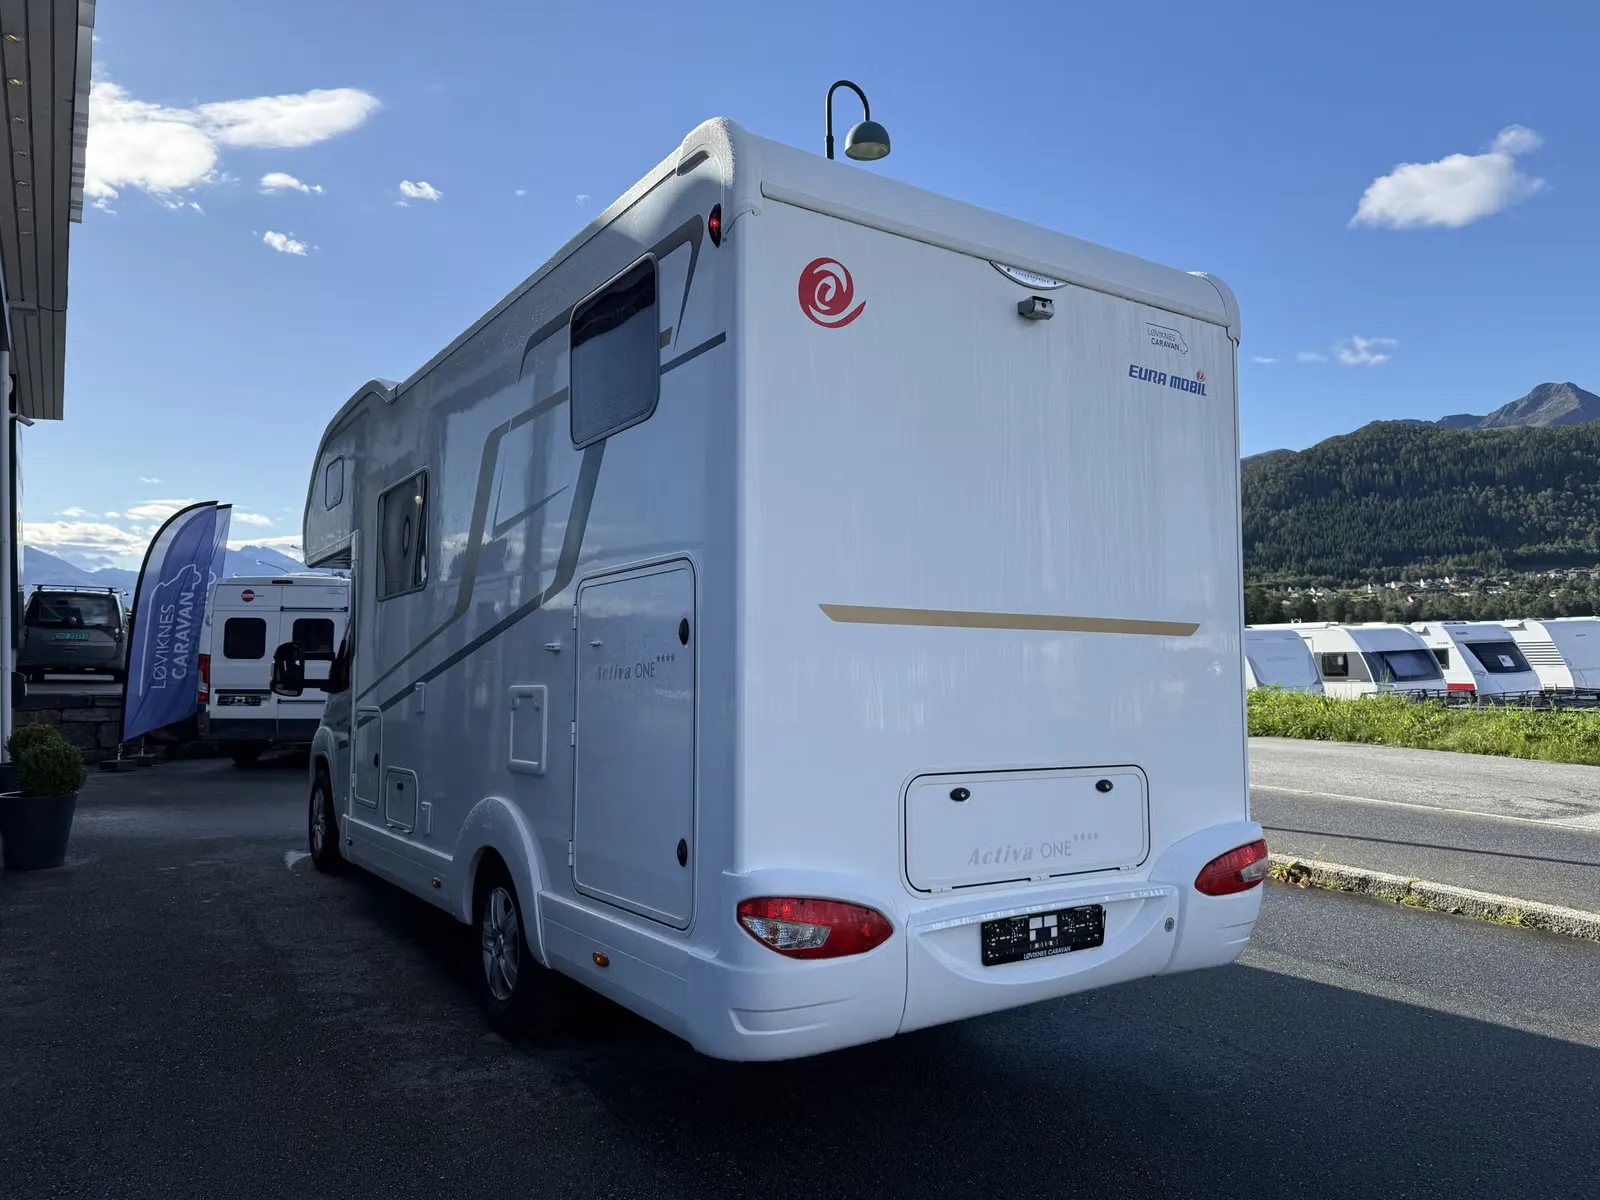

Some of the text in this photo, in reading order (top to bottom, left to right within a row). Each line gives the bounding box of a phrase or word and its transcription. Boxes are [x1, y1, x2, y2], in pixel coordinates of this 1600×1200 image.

[1151, 338, 1180, 351] CARAVAN
[1128, 364, 1207, 396] EURA MOBIL
[151, 604, 175, 689] LØVIKNES
[172, 592, 194, 680] CARAVAN
[635, 662, 655, 678] ONE
[967, 840, 1072, 866] Activa ONE
[1047, 946, 1071, 955] CARAVAN
